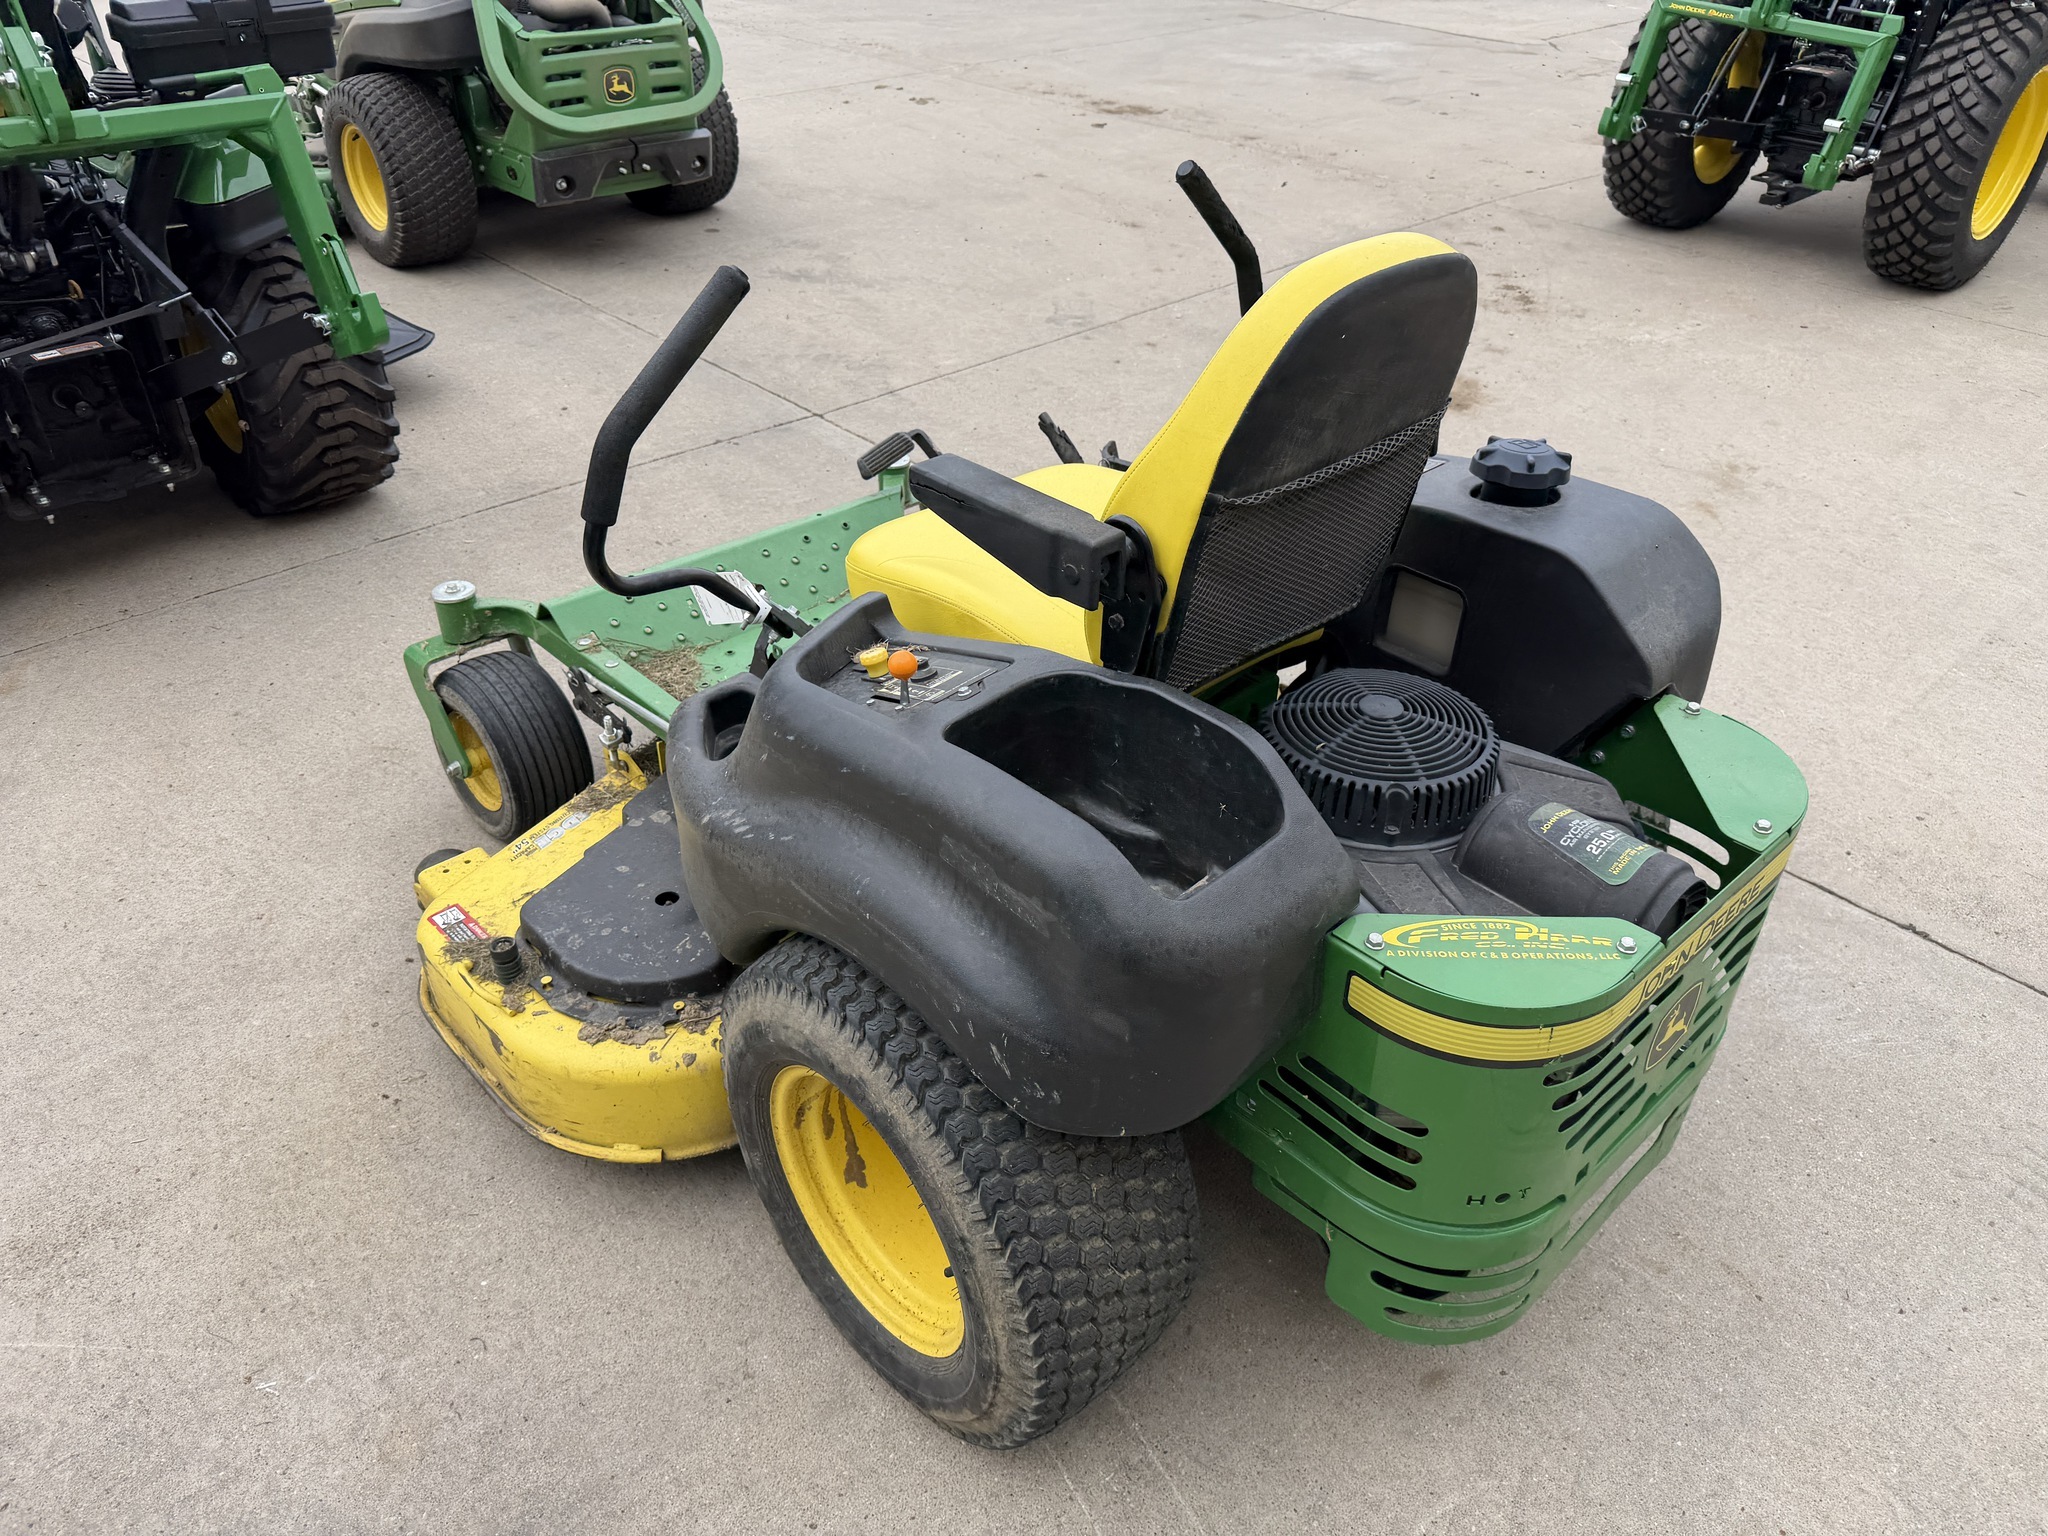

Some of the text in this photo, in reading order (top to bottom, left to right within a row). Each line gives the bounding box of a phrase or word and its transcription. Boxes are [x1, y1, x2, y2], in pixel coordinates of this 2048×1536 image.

[1669, 2, 1685, 11] JOHN
[1686, 5, 1706, 14] DEERE
[1540, 815, 1559, 834] JOHN
[1586, 832, 1616, 855] 25.0
[1612, 856, 1631, 875] MADE
[1440, 922, 1511, 931] SINCE 1882
[1407, 927, 1612, 947] FRED HAAR
[1628, 876, 1766, 1017] JOHN DEERE
[1386, 949, 1395, 957] A
[1397, 950, 1458, 958] DIVISION
[1511, 952, 1598, 960] OPERATIONS,
[1599, 952, 1621, 960] LLC
[1466, 1187, 1531, 1206] HOT
